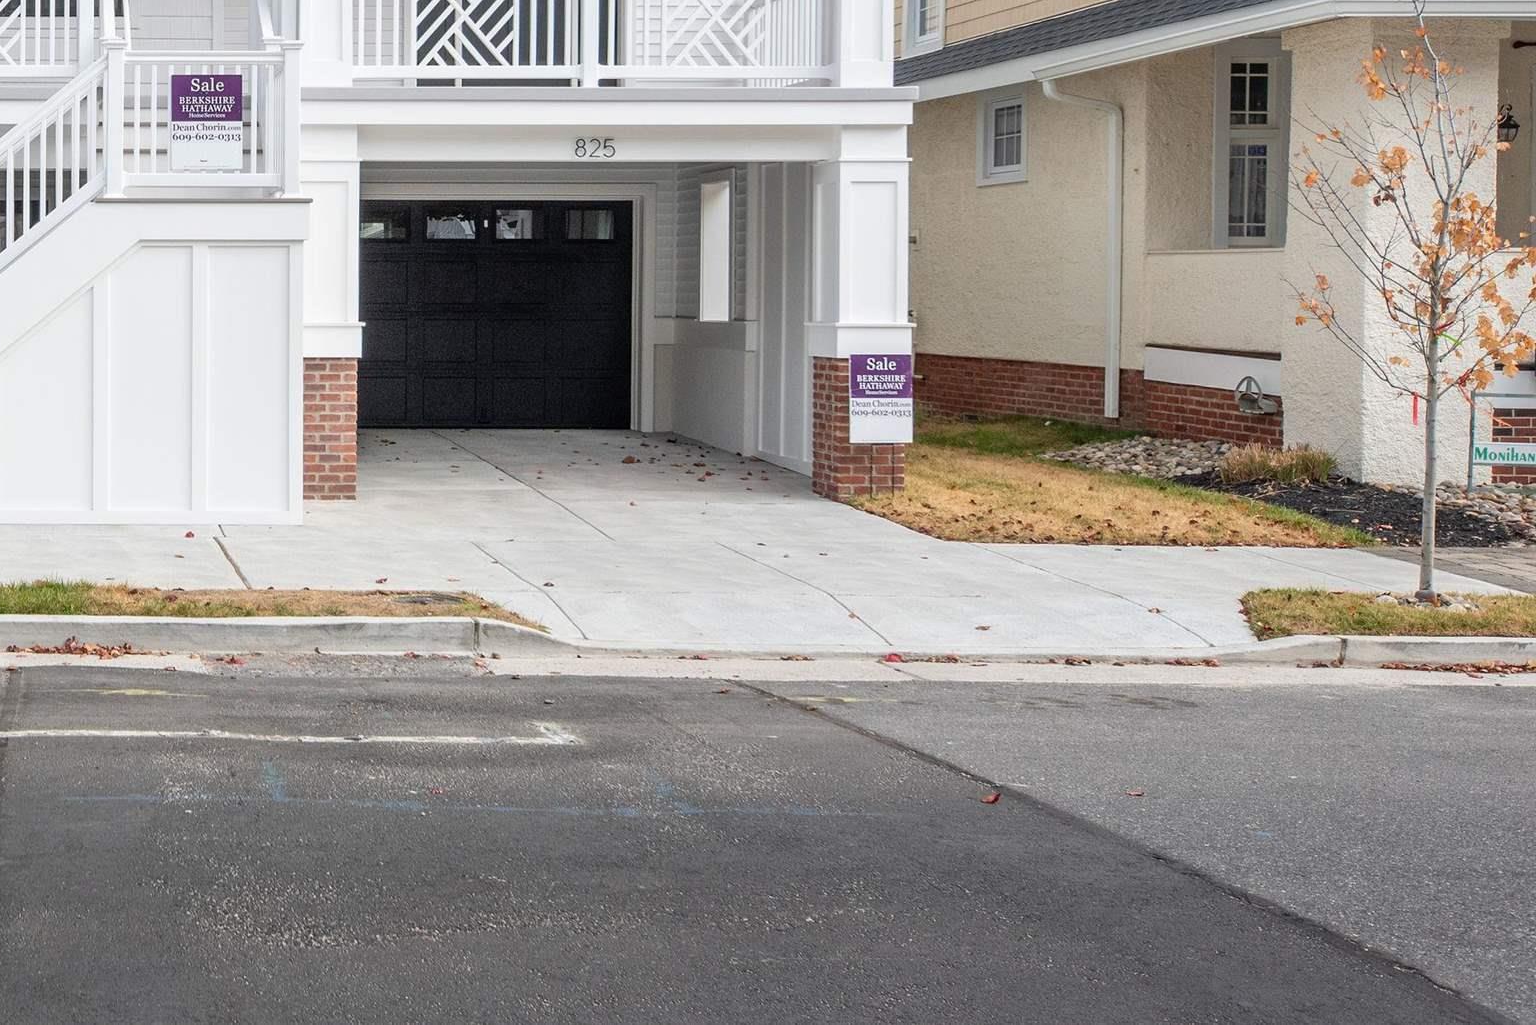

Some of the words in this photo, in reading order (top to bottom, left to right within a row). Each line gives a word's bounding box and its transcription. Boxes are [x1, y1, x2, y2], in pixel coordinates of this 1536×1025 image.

[190, 77, 225, 92] Sale
[179, 96, 236, 104] BERKSHIRE
[182, 104, 233, 113] HATHAWAY
[172, 133, 242, 142] 609-602-0313
[574, 138, 616, 158] 825
[866, 357, 897, 371] Sale
[859, 382, 904, 390] HATHAWAY
[851, 409, 912, 417] 609-602-0313
